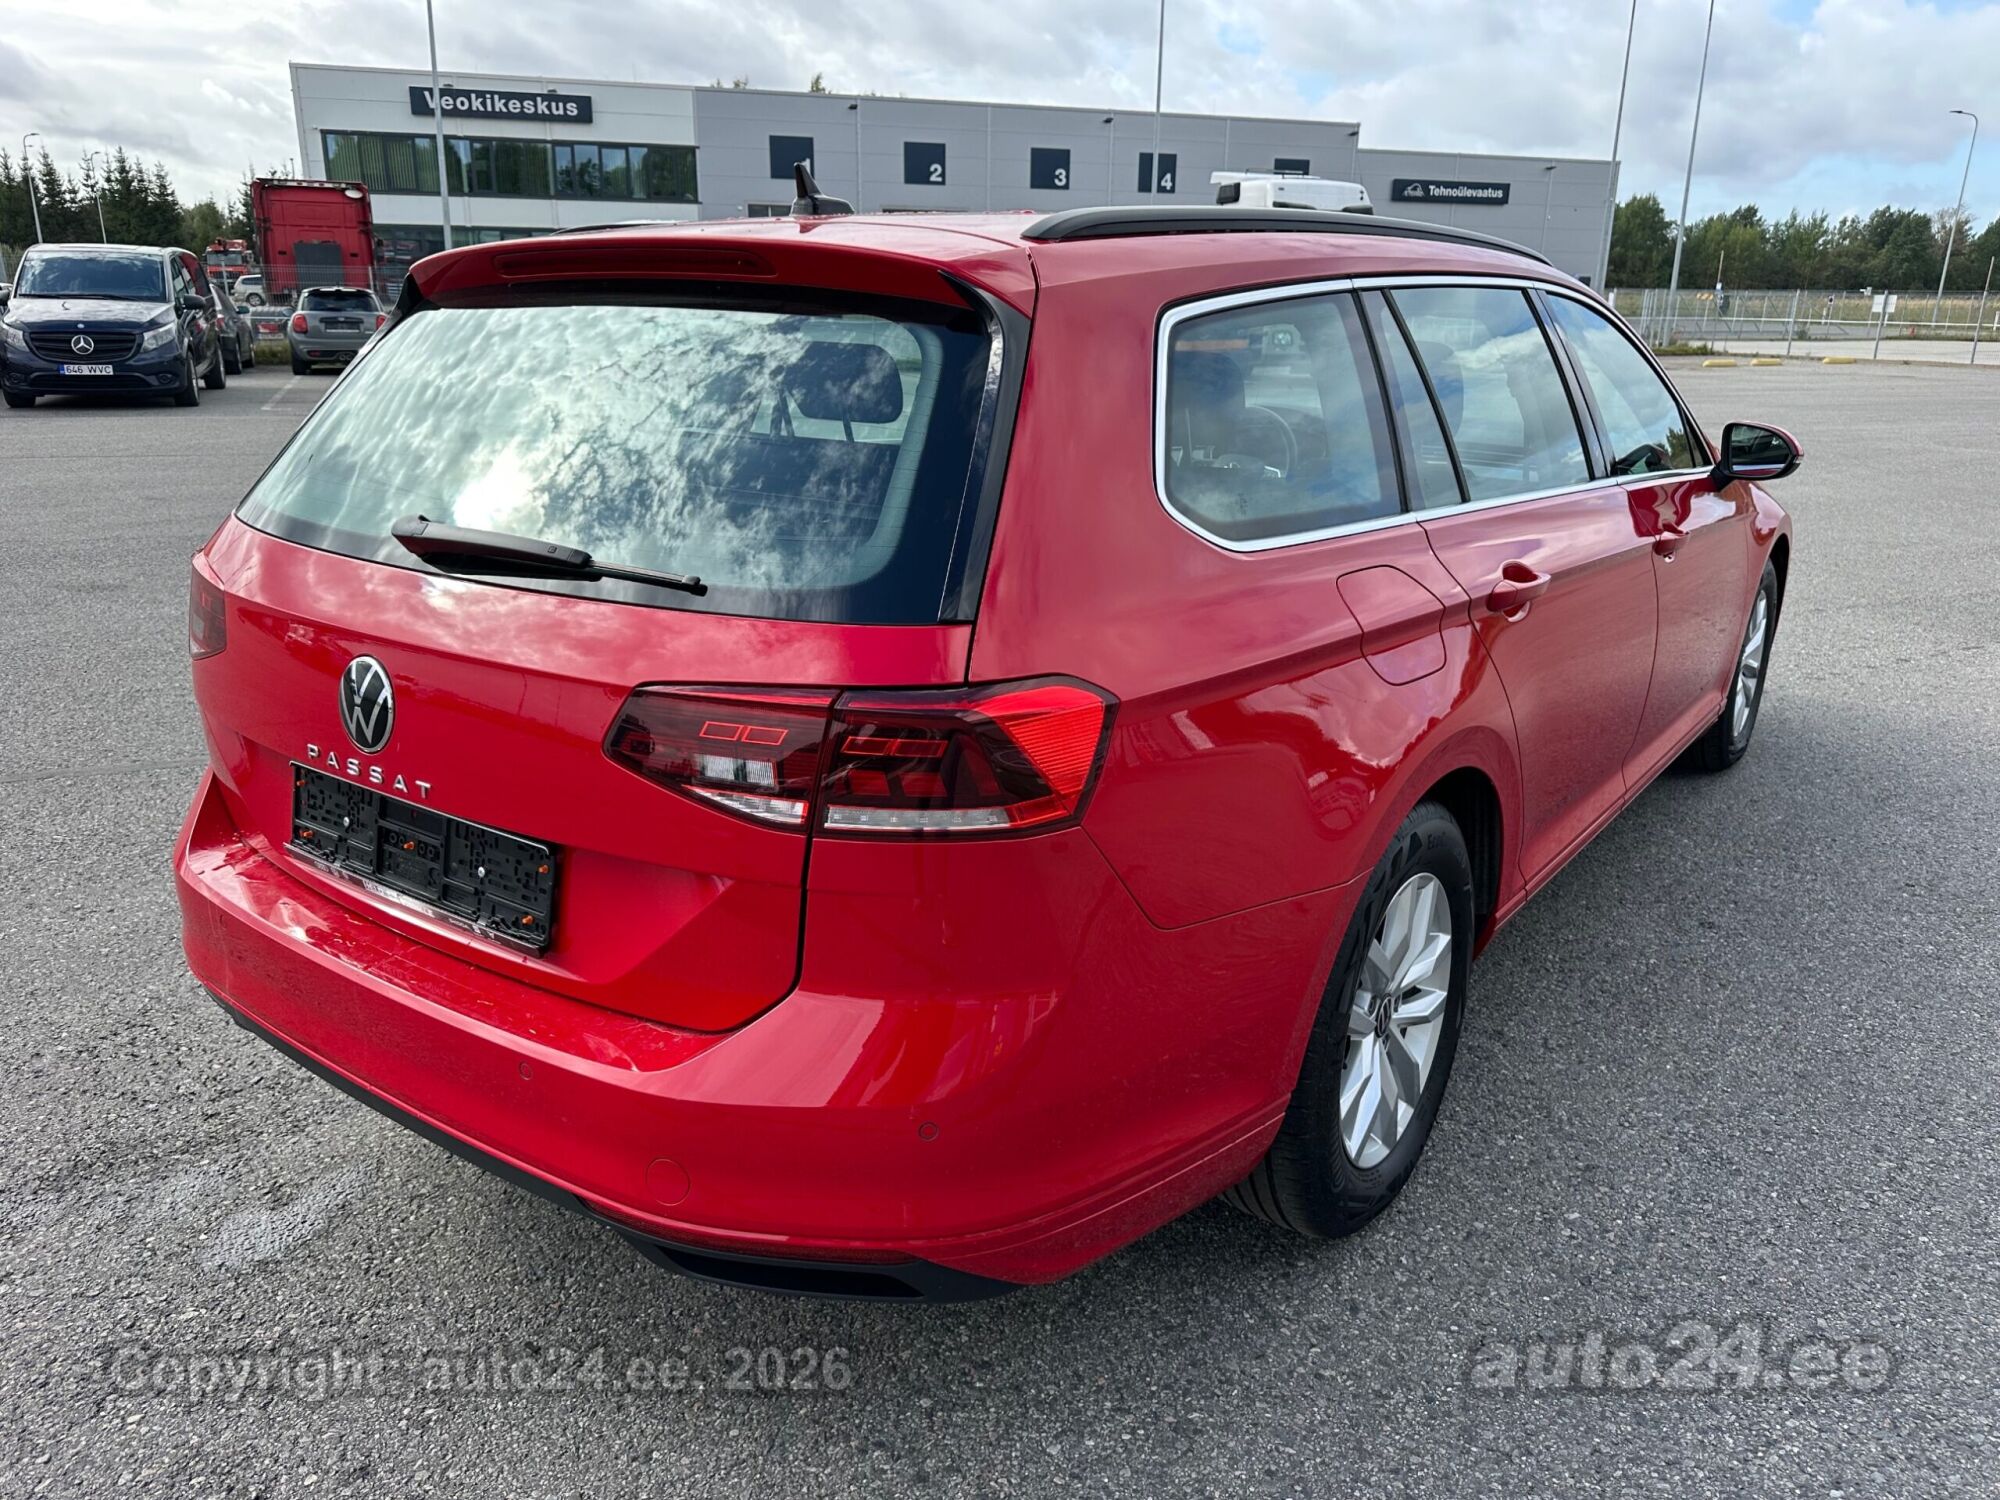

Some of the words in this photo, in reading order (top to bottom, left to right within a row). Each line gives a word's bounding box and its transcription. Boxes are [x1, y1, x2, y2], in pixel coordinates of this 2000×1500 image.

[423, 90, 579, 116] Veokikeskus
[929, 163, 943, 182] 2
[1054, 168, 1067, 186] 3
[1160, 173, 1173, 190] 4
[1428, 185, 1504, 198] Tehnoülevaatus
[66, 365, 84, 374] 646
[87, 365, 112, 374] WVC
[307, 743, 432, 799] PASSAT
